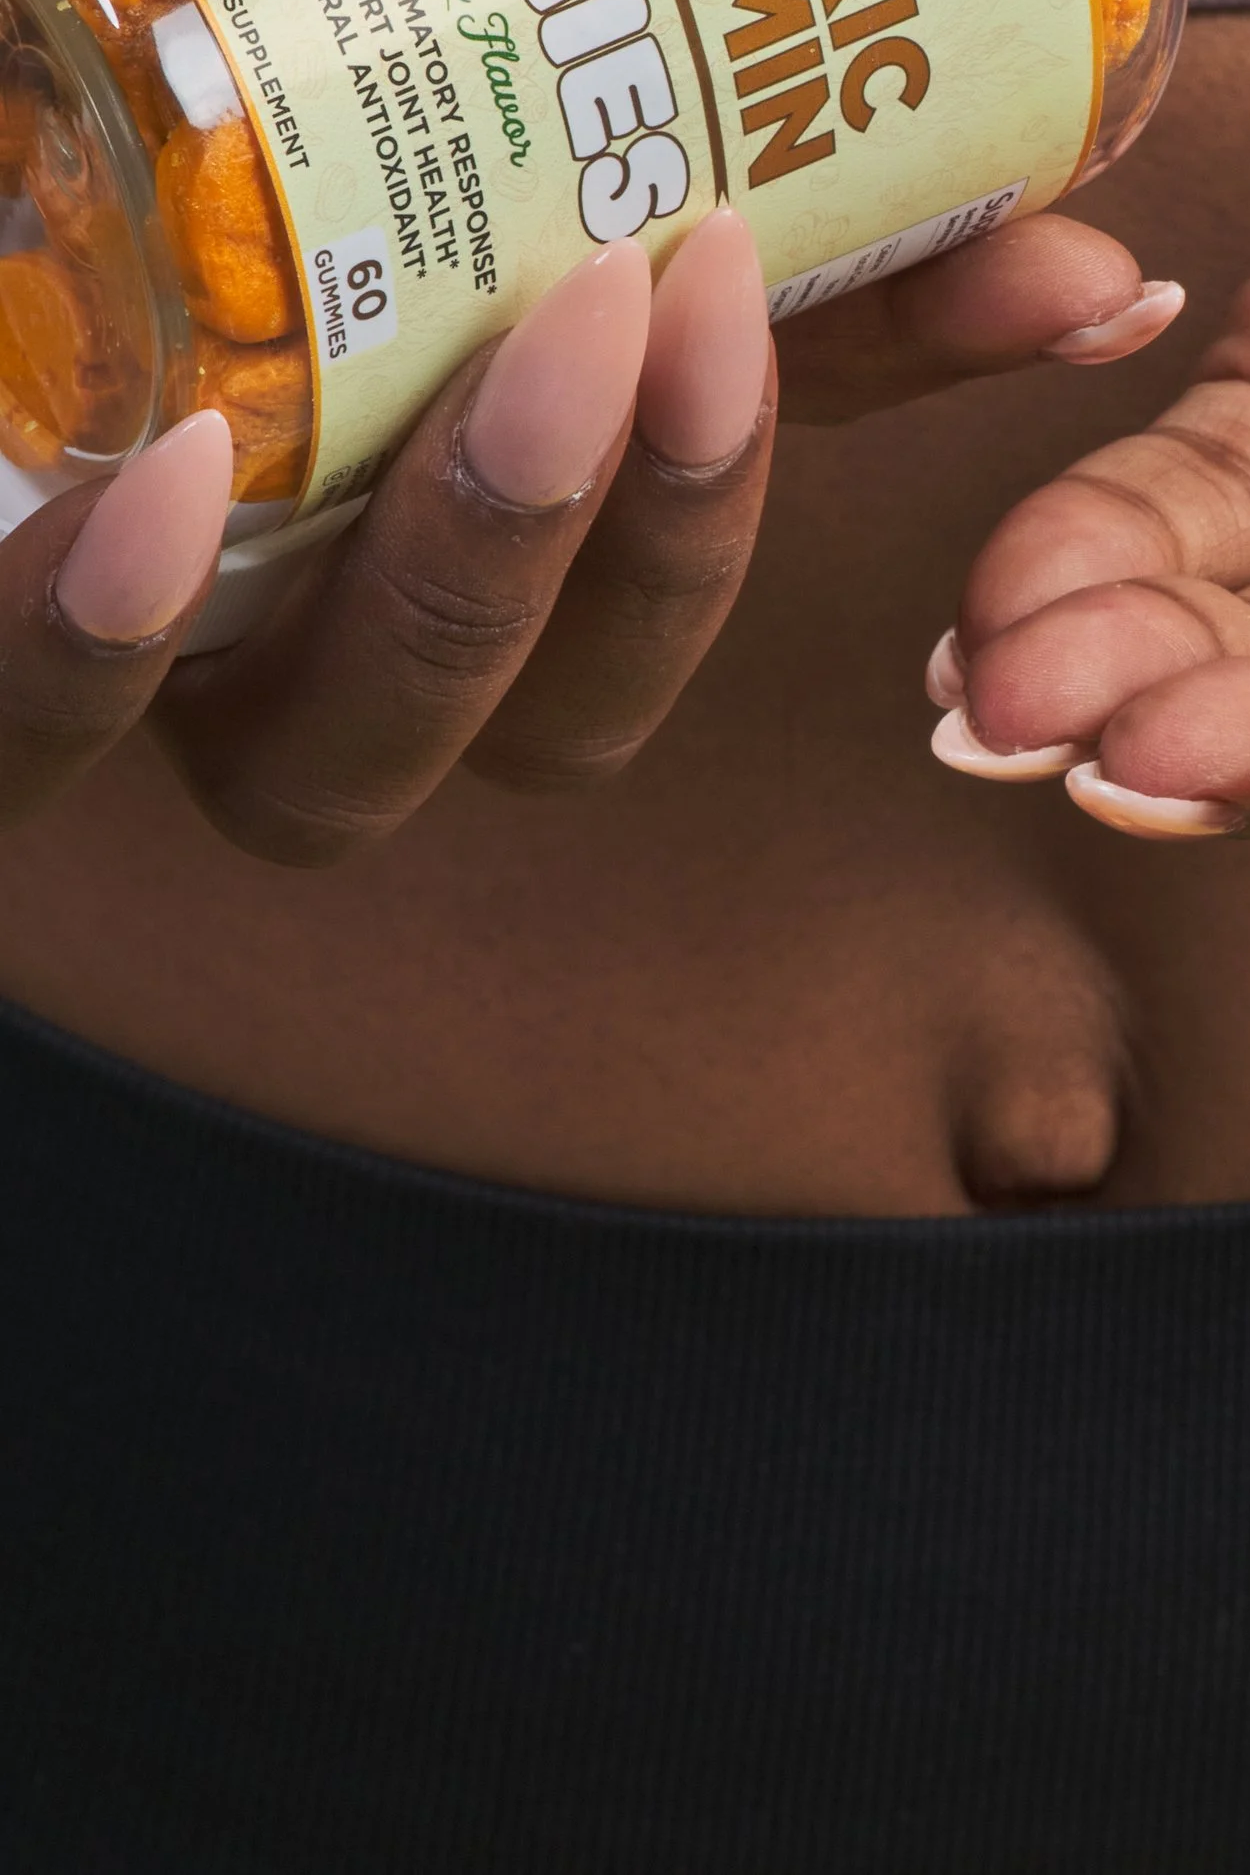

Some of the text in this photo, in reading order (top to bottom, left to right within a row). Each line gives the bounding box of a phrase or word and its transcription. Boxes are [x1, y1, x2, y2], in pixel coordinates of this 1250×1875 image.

[379, 47, 430, 137] JOINT
[457, 11, 535, 167] Flavor
[313, 249, 348, 360] GUMMIES
[346, 258, 388, 322] 60
